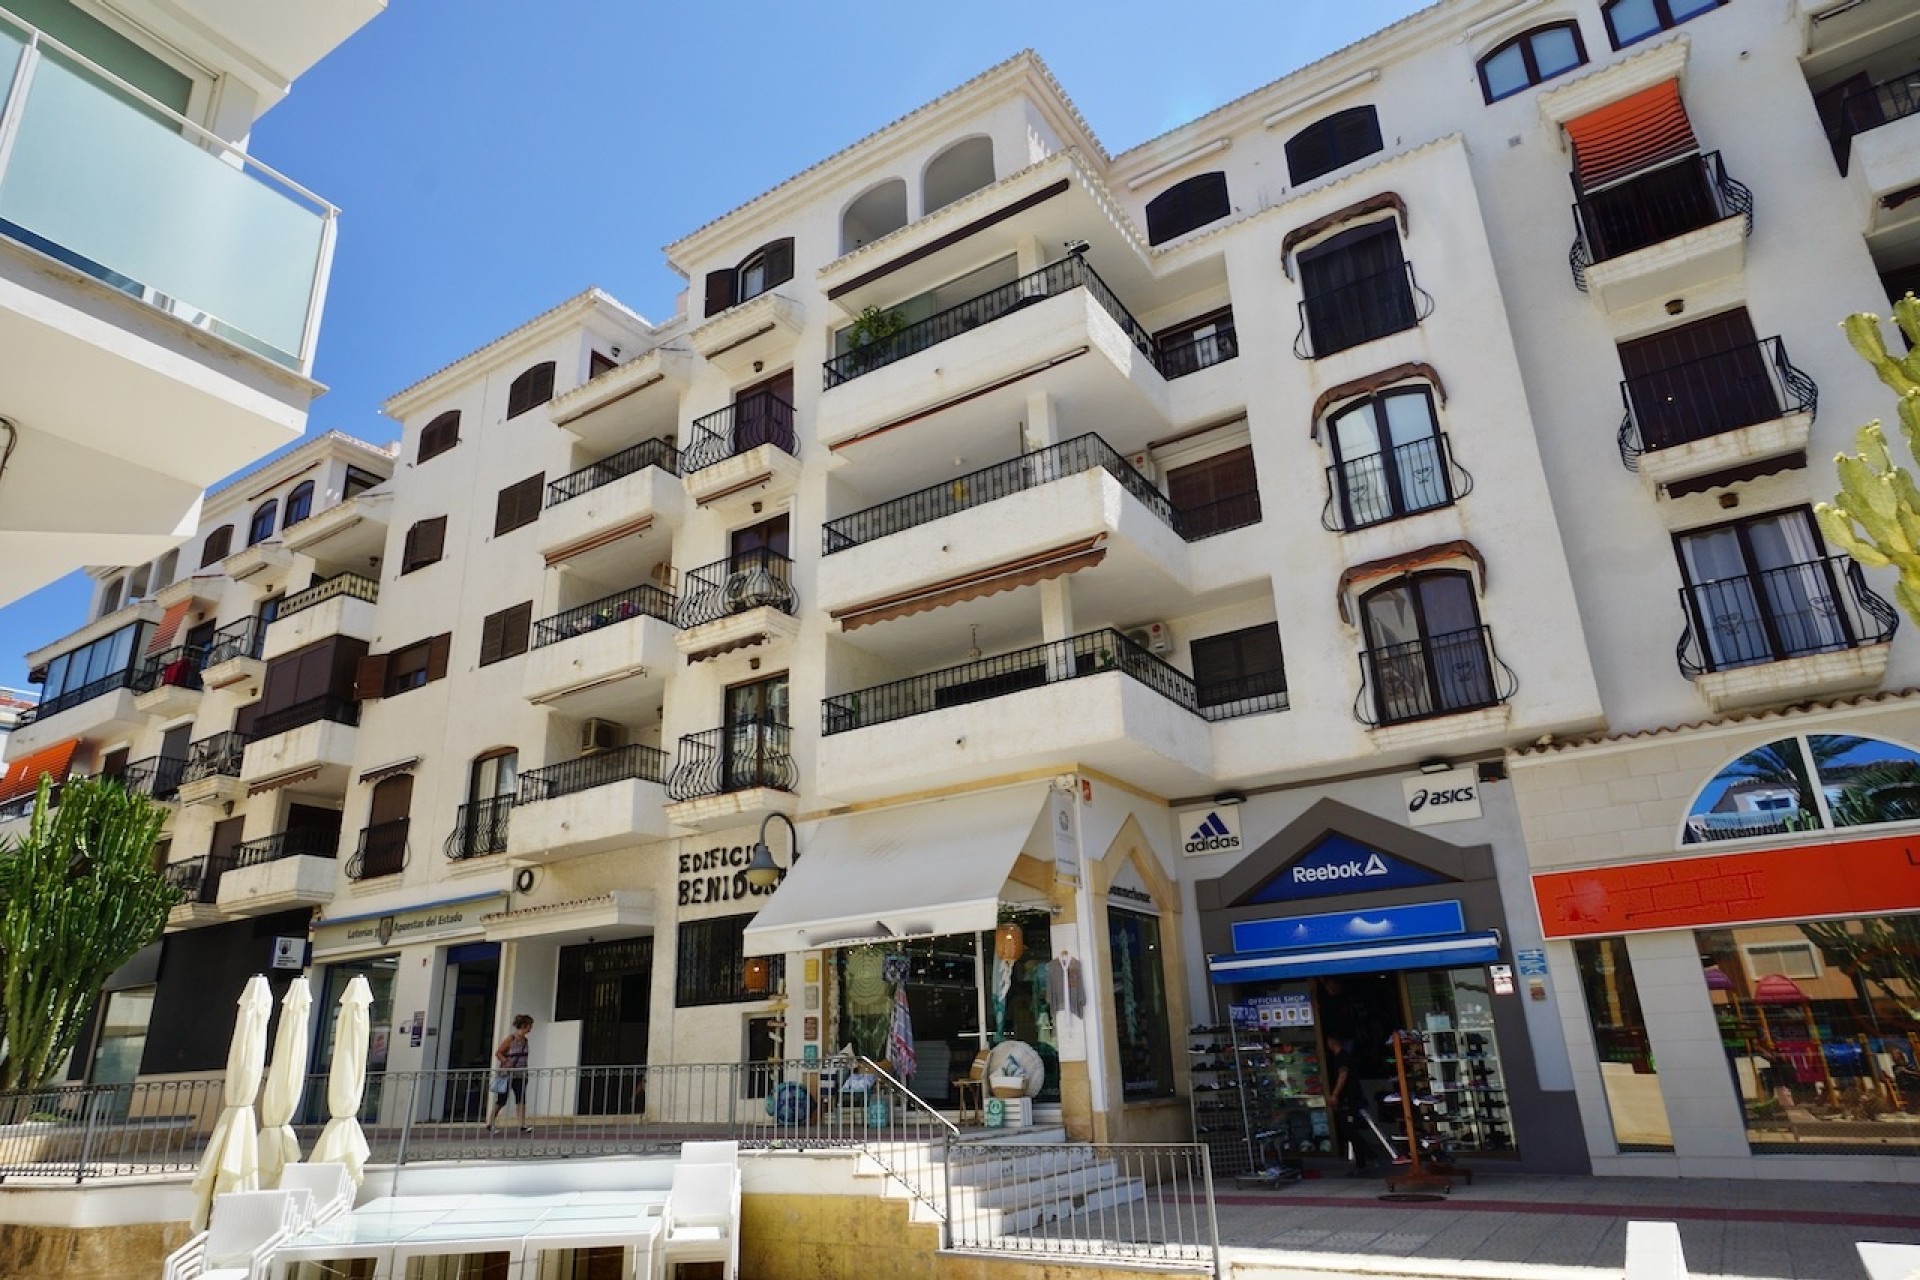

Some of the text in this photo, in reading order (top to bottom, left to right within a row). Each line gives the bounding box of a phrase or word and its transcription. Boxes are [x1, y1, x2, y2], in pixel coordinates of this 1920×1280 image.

[1430, 786, 1474, 805] asics
[1184, 836, 1240, 853] adidas
[679, 842, 763, 874] EDIFICI
[1292, 861, 1363, 883] Reebok
[425, 915, 437, 926] del
[438, 912, 462, 925] Estado
[1283, 995, 1306, 1003] SHOP
